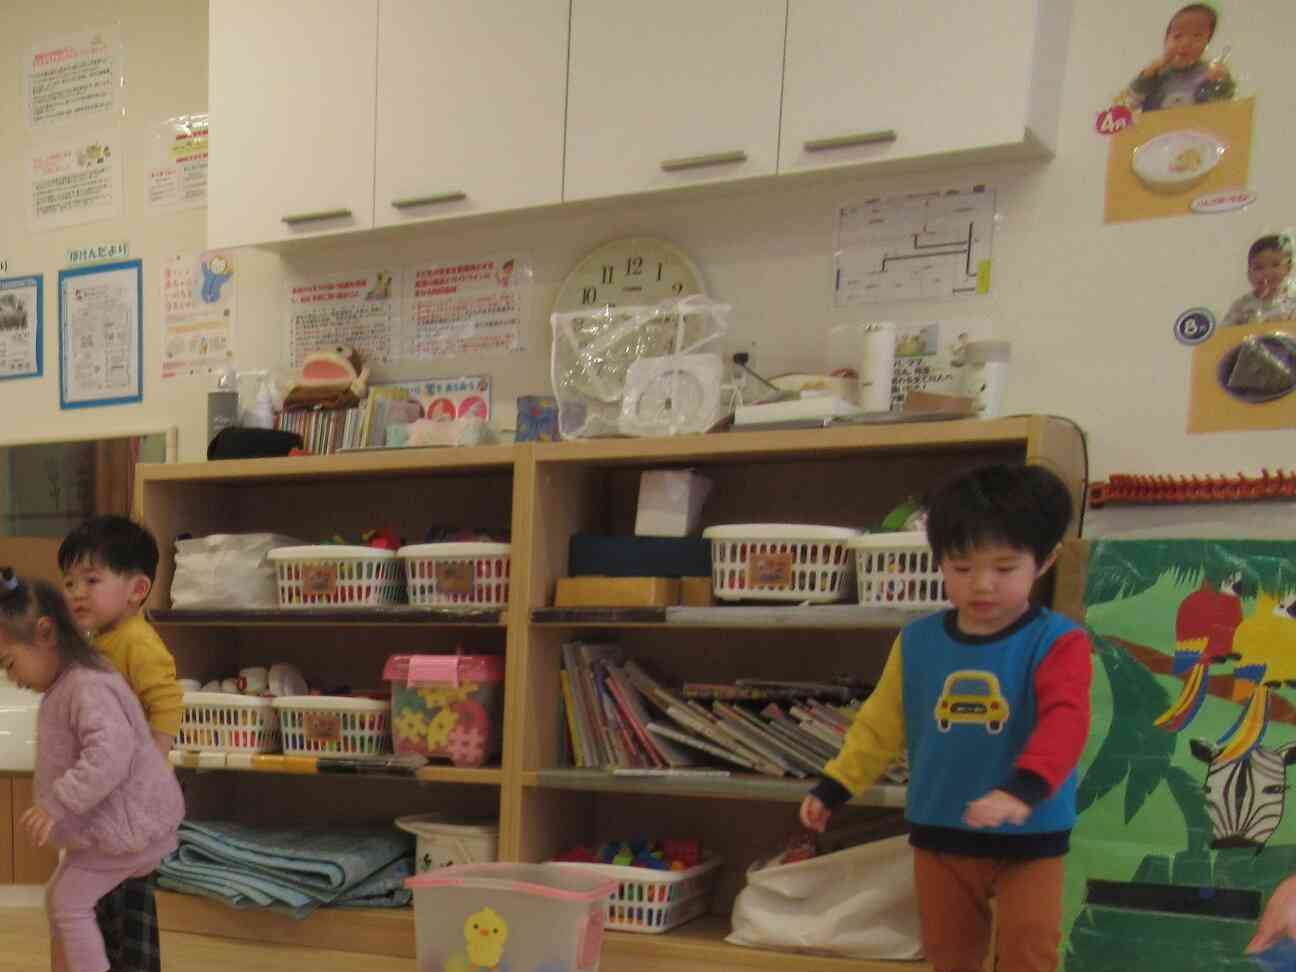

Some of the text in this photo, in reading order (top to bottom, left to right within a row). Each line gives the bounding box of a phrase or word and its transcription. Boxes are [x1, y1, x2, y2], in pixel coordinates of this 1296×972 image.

[600, 264, 615, 285] 11
[624, 256, 644, 276] 12
[656, 262, 664, 282] 1
[582, 287, 599, 305] 10
